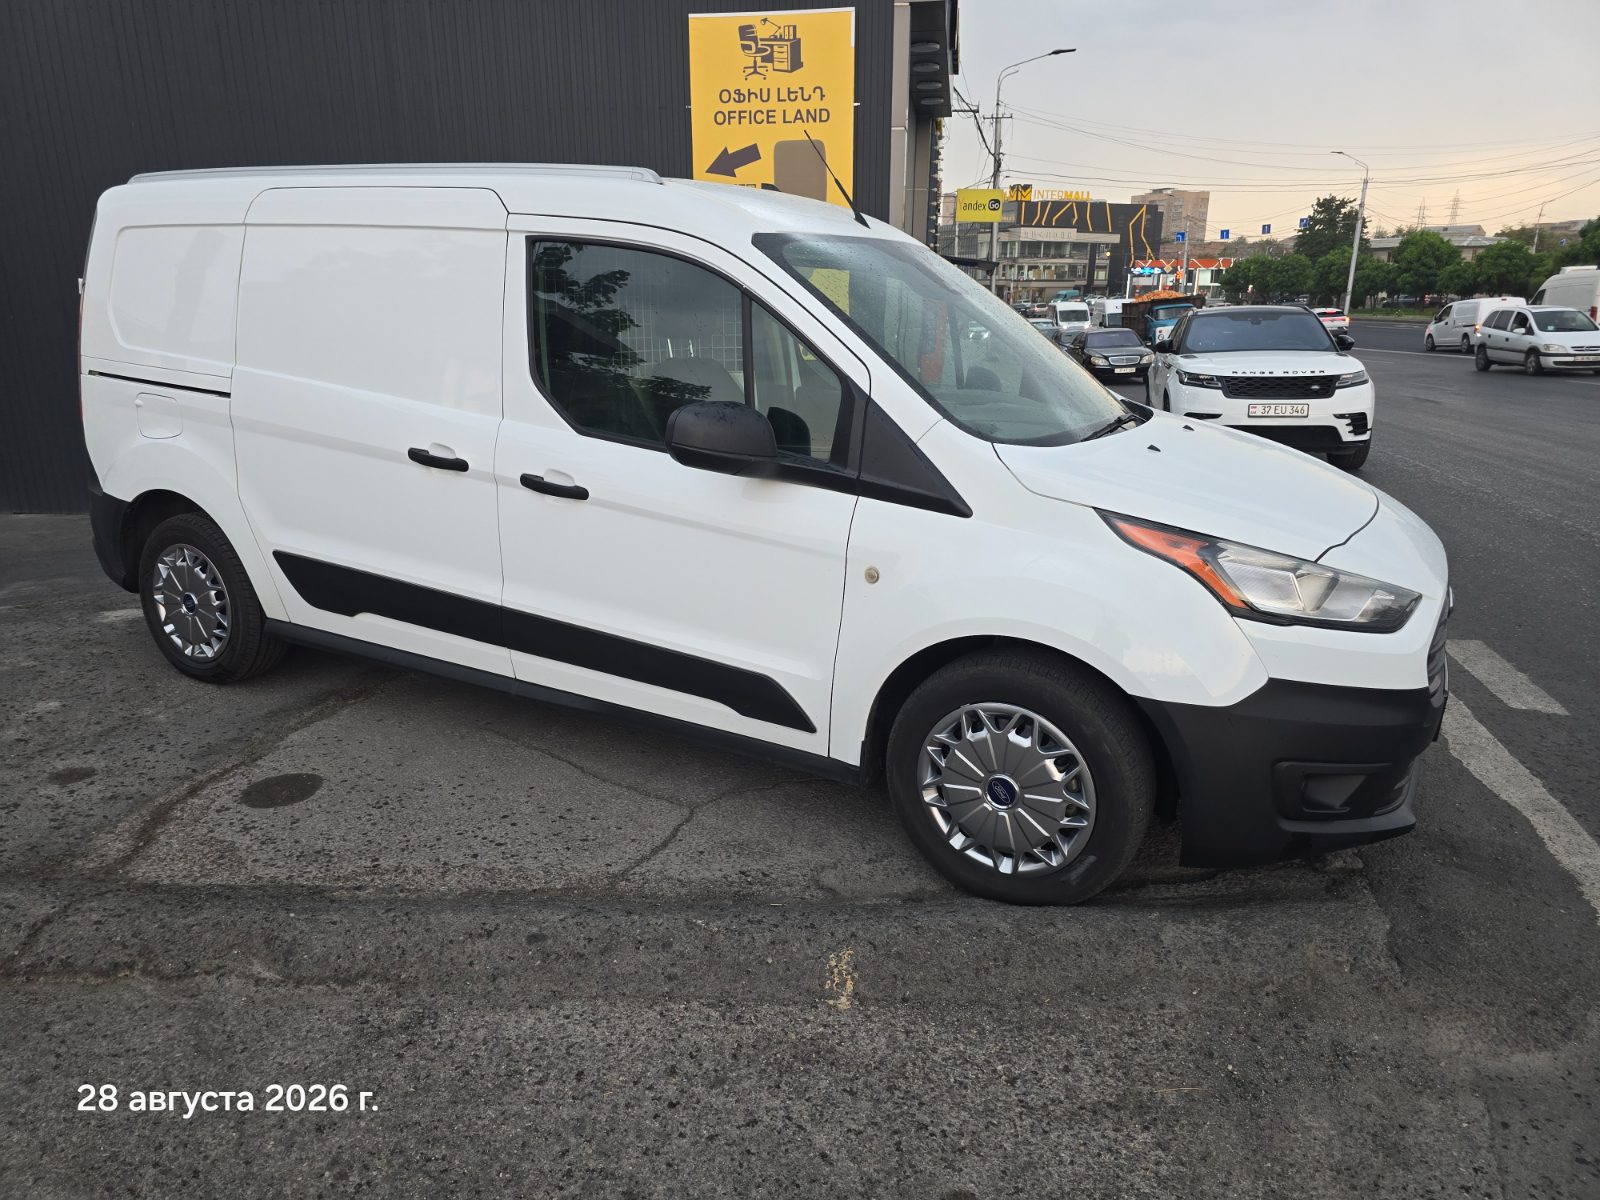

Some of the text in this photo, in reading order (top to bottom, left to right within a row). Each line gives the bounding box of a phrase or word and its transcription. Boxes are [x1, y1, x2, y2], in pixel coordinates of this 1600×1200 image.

[718, 85, 826, 104] ՕՖԻՍ ԼԵՆԴ
[713, 108, 831, 126] OFFICE LAND
[1034, 189, 1092, 201] INTERMALL
[989, 200, 1000, 210] Go
[1260, 405, 1305, 415] 37 EU 346
